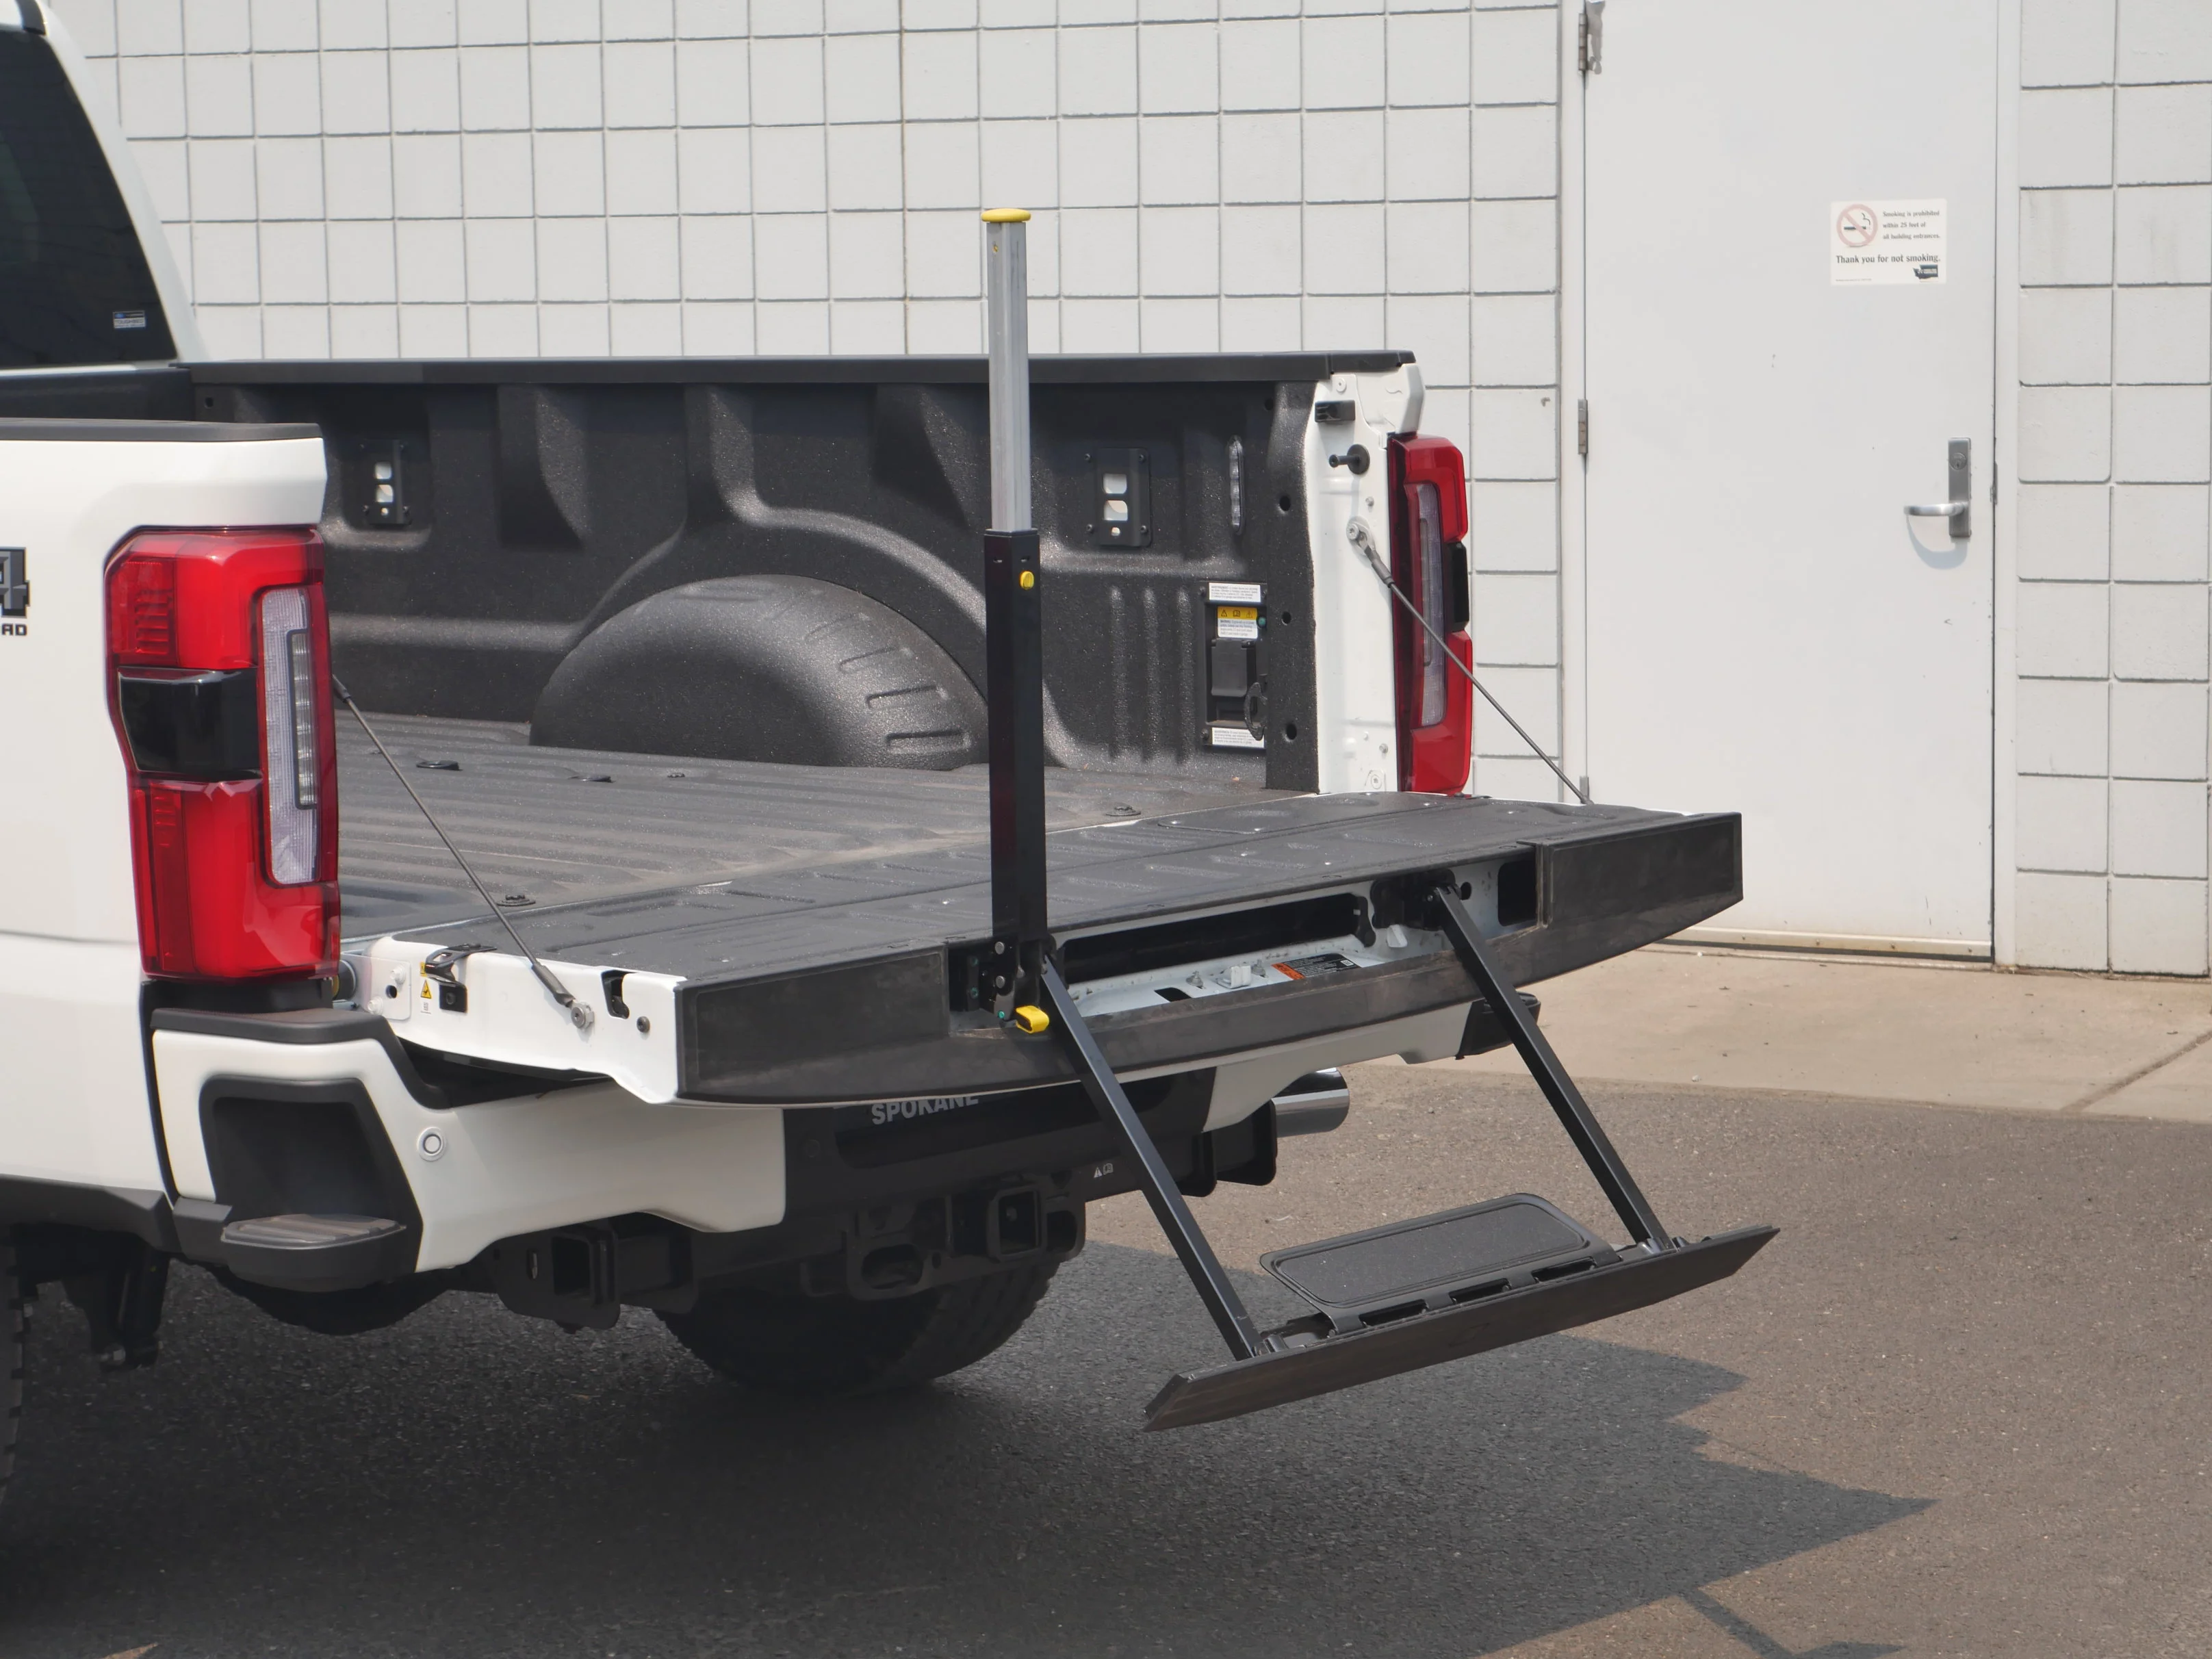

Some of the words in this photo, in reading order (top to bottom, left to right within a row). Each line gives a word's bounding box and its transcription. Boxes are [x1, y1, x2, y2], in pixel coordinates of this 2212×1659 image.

[1836, 255, 1859, 263] Thank
[1862, 256, 1875, 264] you
[1877, 254, 1888, 263] for
[1906, 254, 1941, 263] smoking.
